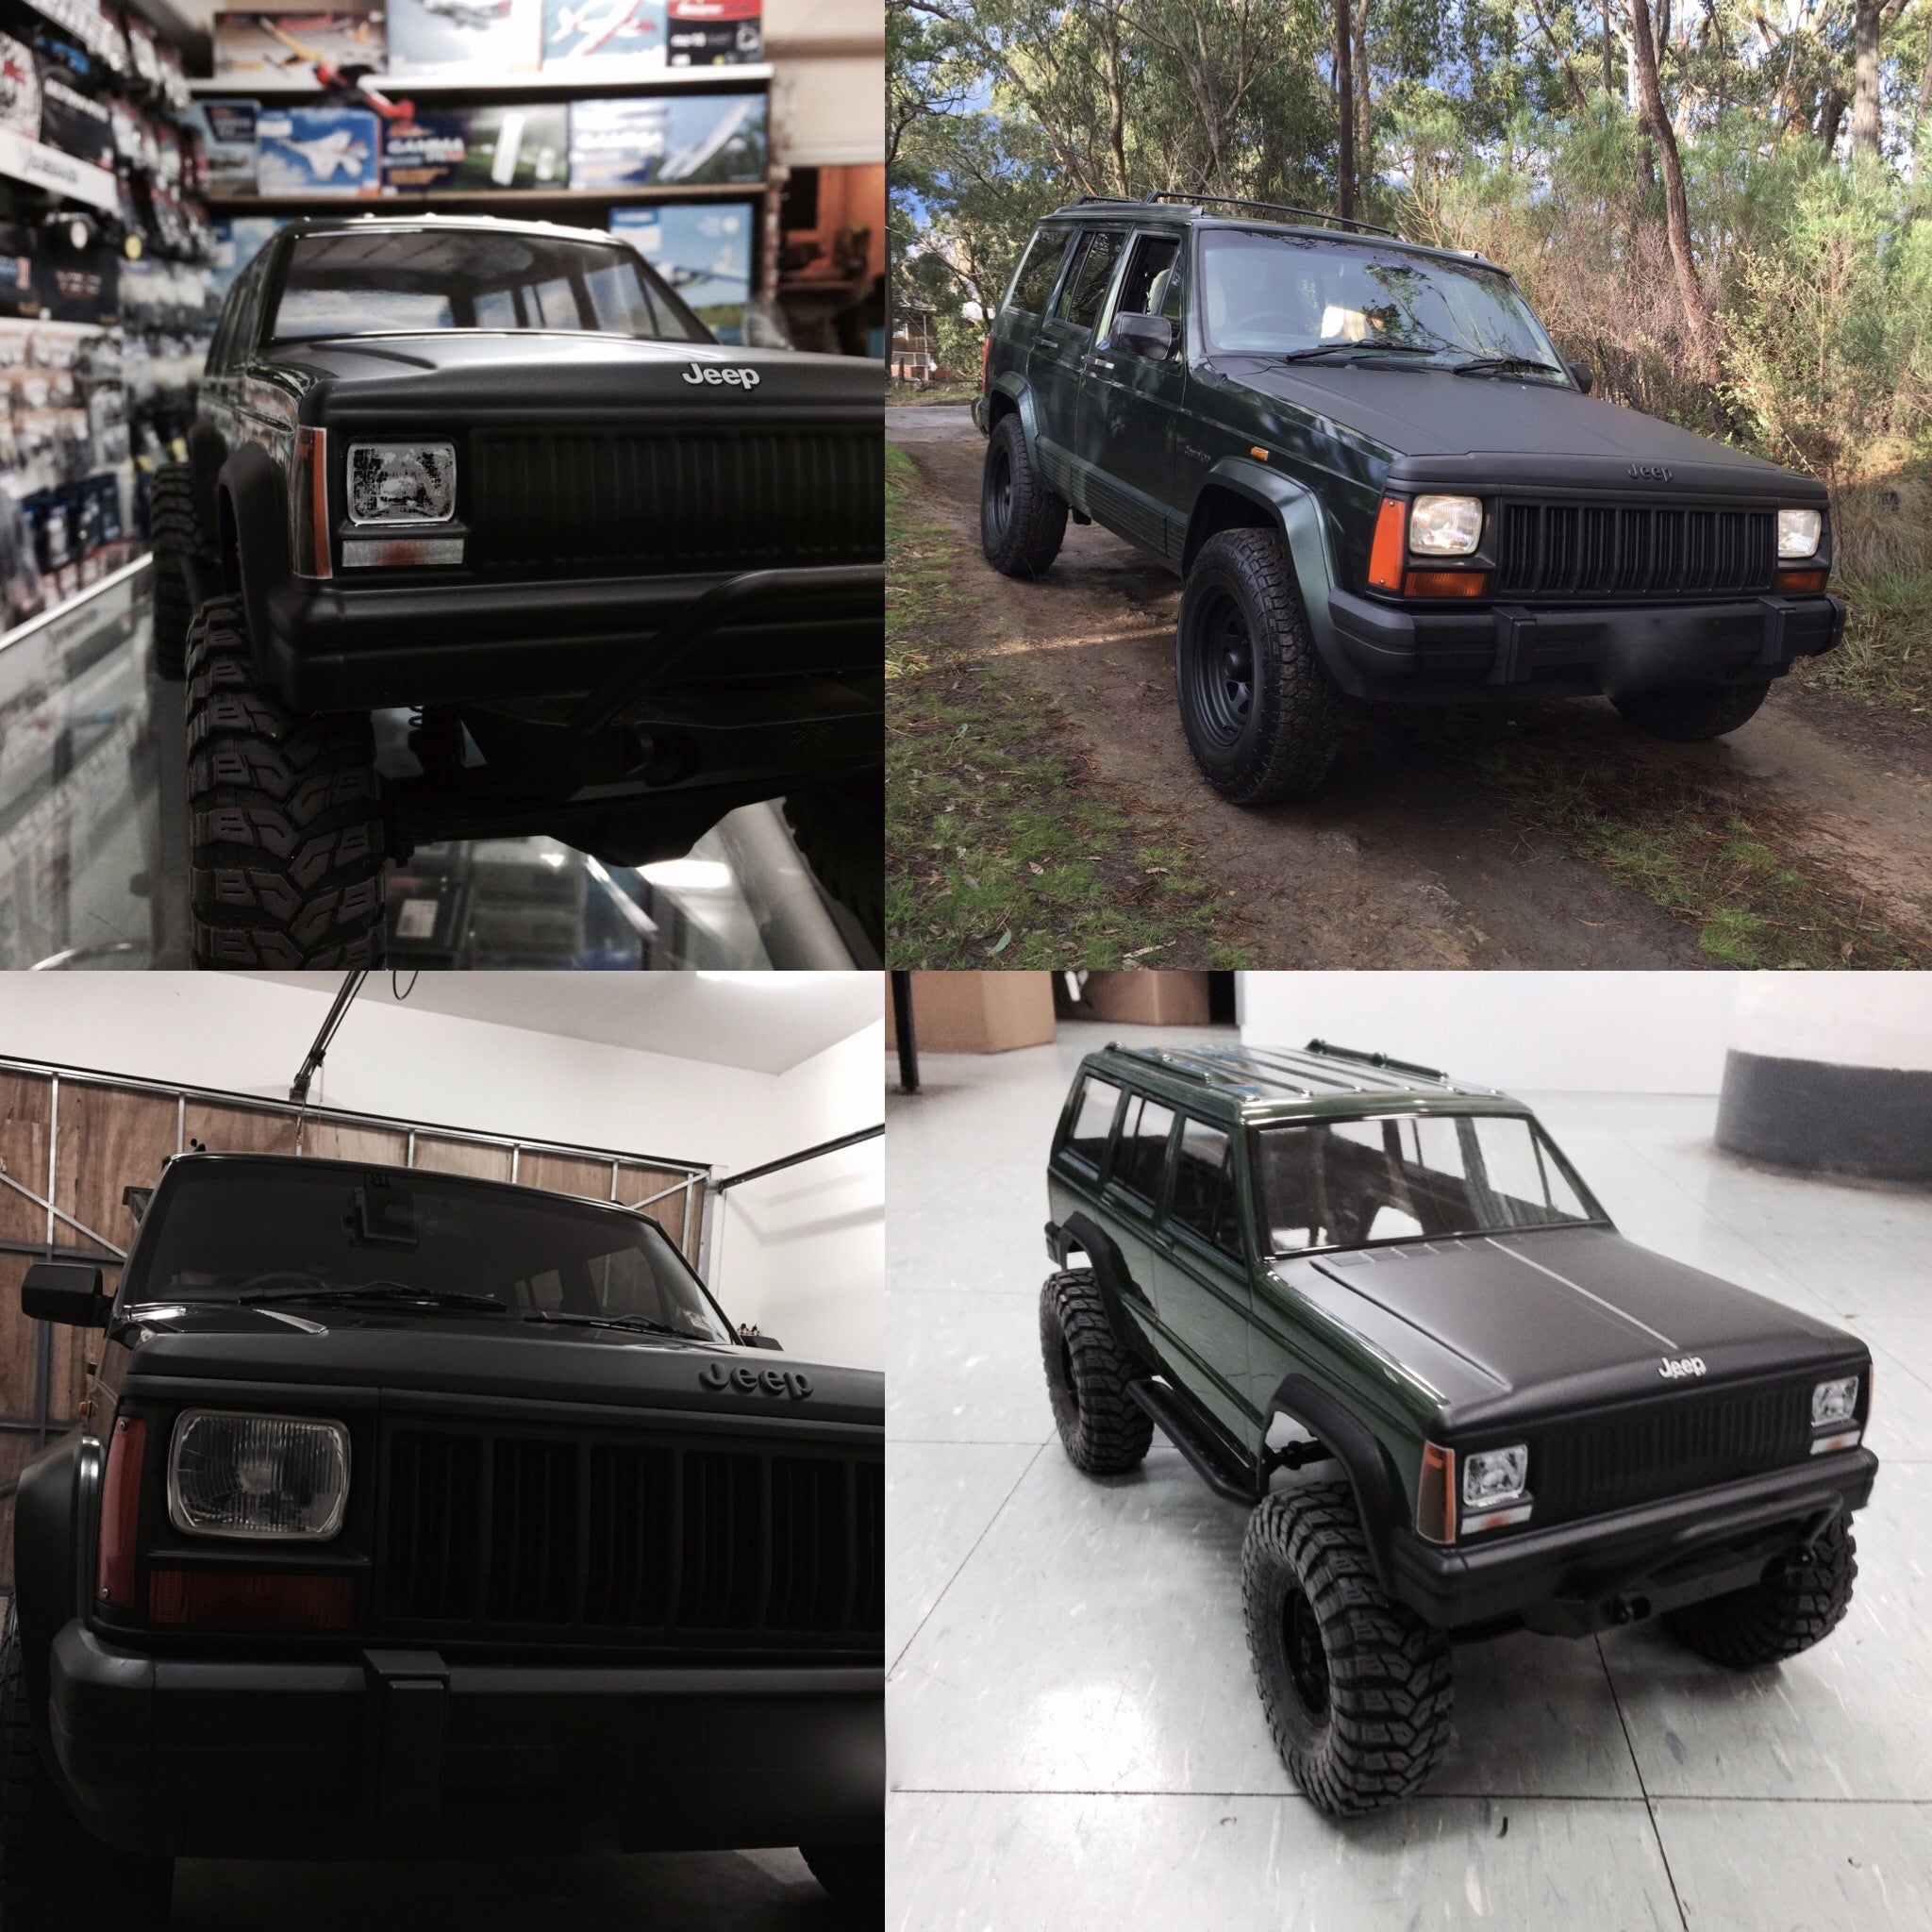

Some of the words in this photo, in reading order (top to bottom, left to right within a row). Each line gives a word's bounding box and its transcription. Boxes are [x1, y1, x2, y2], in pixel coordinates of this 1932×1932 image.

[682, 363, 760, 390] Jeep
[1627, 463, 1674, 483] Jeep
[1657, 1357, 1707, 1378] Jeep
[698, 1361, 814, 1399] Jeep
